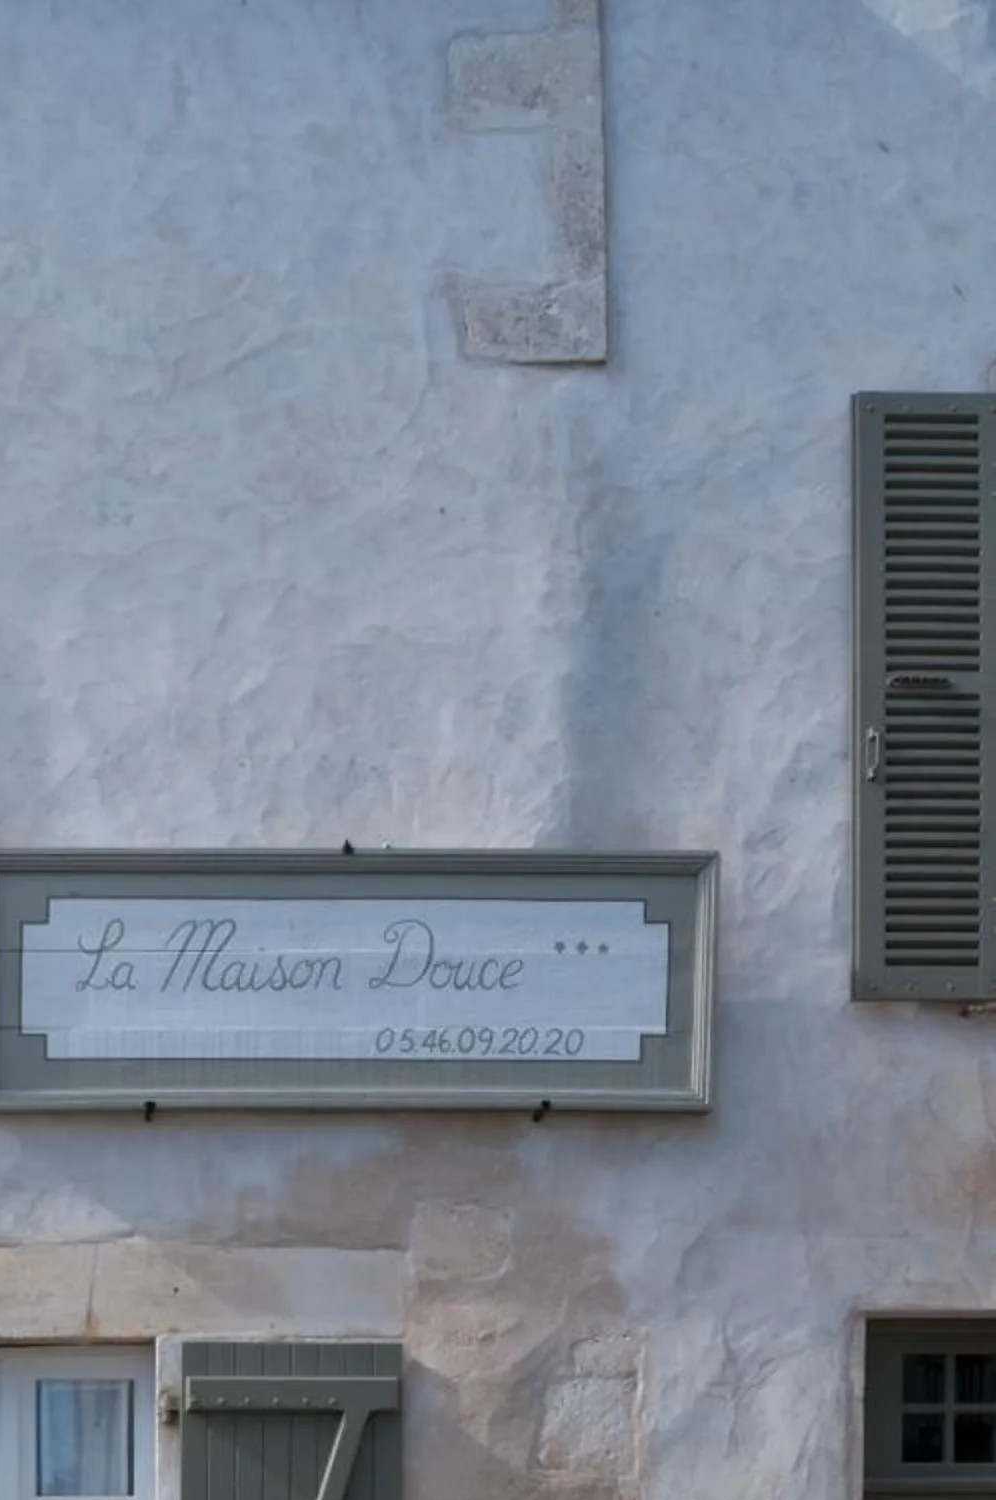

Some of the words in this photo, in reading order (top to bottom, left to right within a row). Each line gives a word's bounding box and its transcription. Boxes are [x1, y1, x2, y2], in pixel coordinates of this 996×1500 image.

[76, 918, 137, 992] La
[160, 918, 342, 993] Maison
[369, 919, 524, 991] Douce
